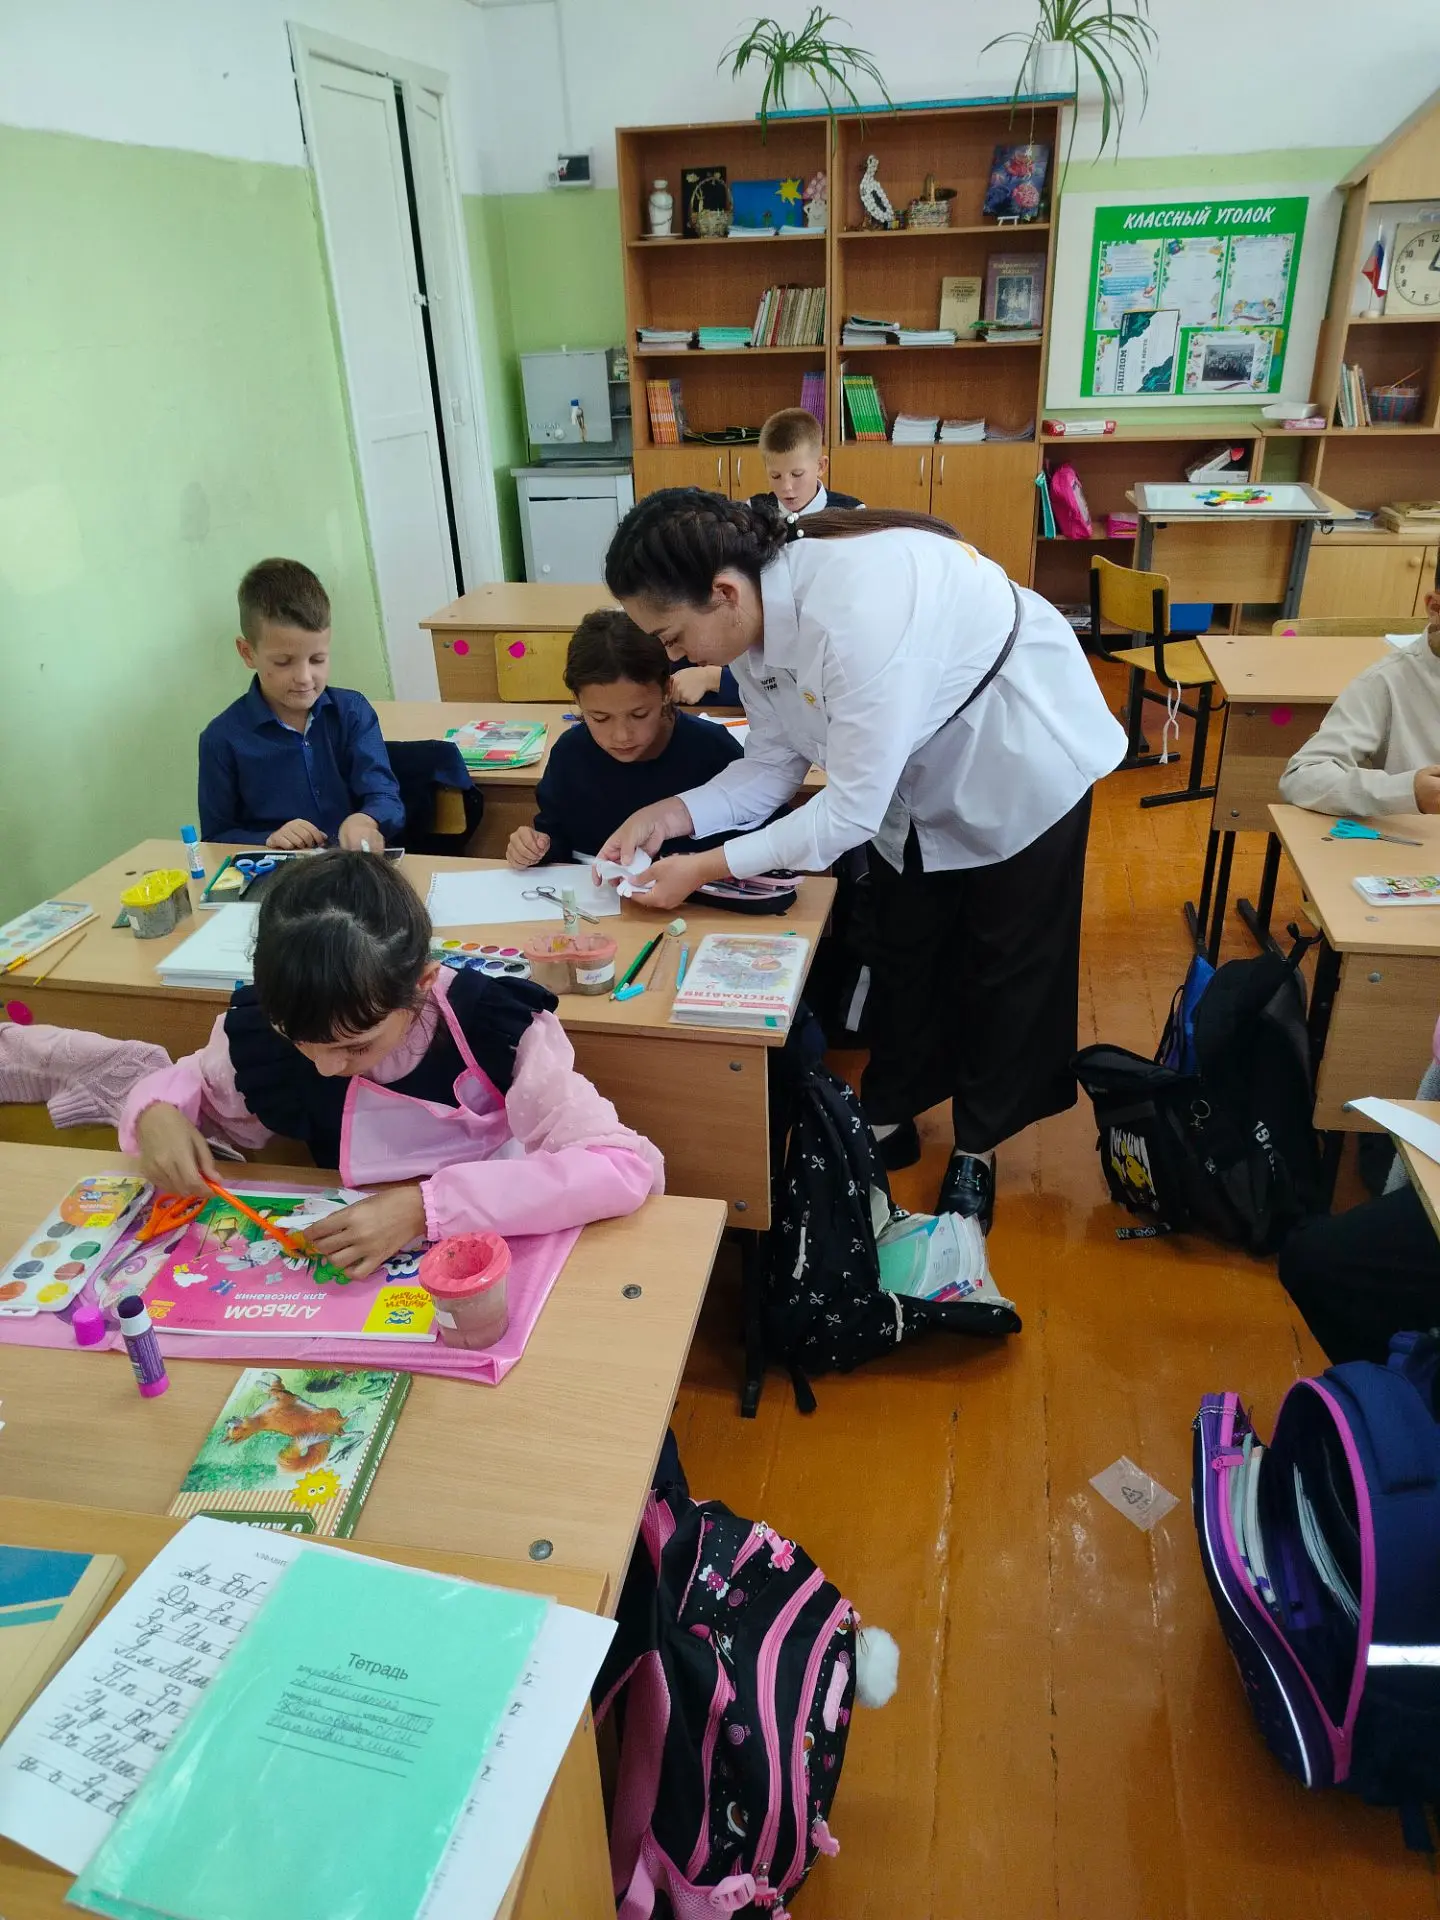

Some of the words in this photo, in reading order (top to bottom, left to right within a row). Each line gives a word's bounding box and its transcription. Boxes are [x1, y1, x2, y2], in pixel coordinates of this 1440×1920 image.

[1122, 206, 1211, 229] КЛАССНЫЙ
[1214, 206, 1276, 225] УГОЛОК
[1431, 234, 1440, 242] 12
[1418, 239, 1425, 247] 11
[1405, 250, 1414, 258] 10
[1400, 265, 1406, 274] 9
[1401, 279, 1407, 287] 8
[1411, 290, 1416, 298] 7
[1424, 293, 1430, 303] 6
[1117, 349, 1127, 392] ДИПЛОМ
[234, 1293, 301, 1301] рисования
[303, 1292, 327, 1301] для
[223, 1304, 322, 1320] АЛЬБОМ
[359, 1469, 376, 1507] РАССКАЗЫ
[378, 1419, 395, 1461] ЖИВОТНЫХ
[348, 1652, 410, 1682] Тетрадь
